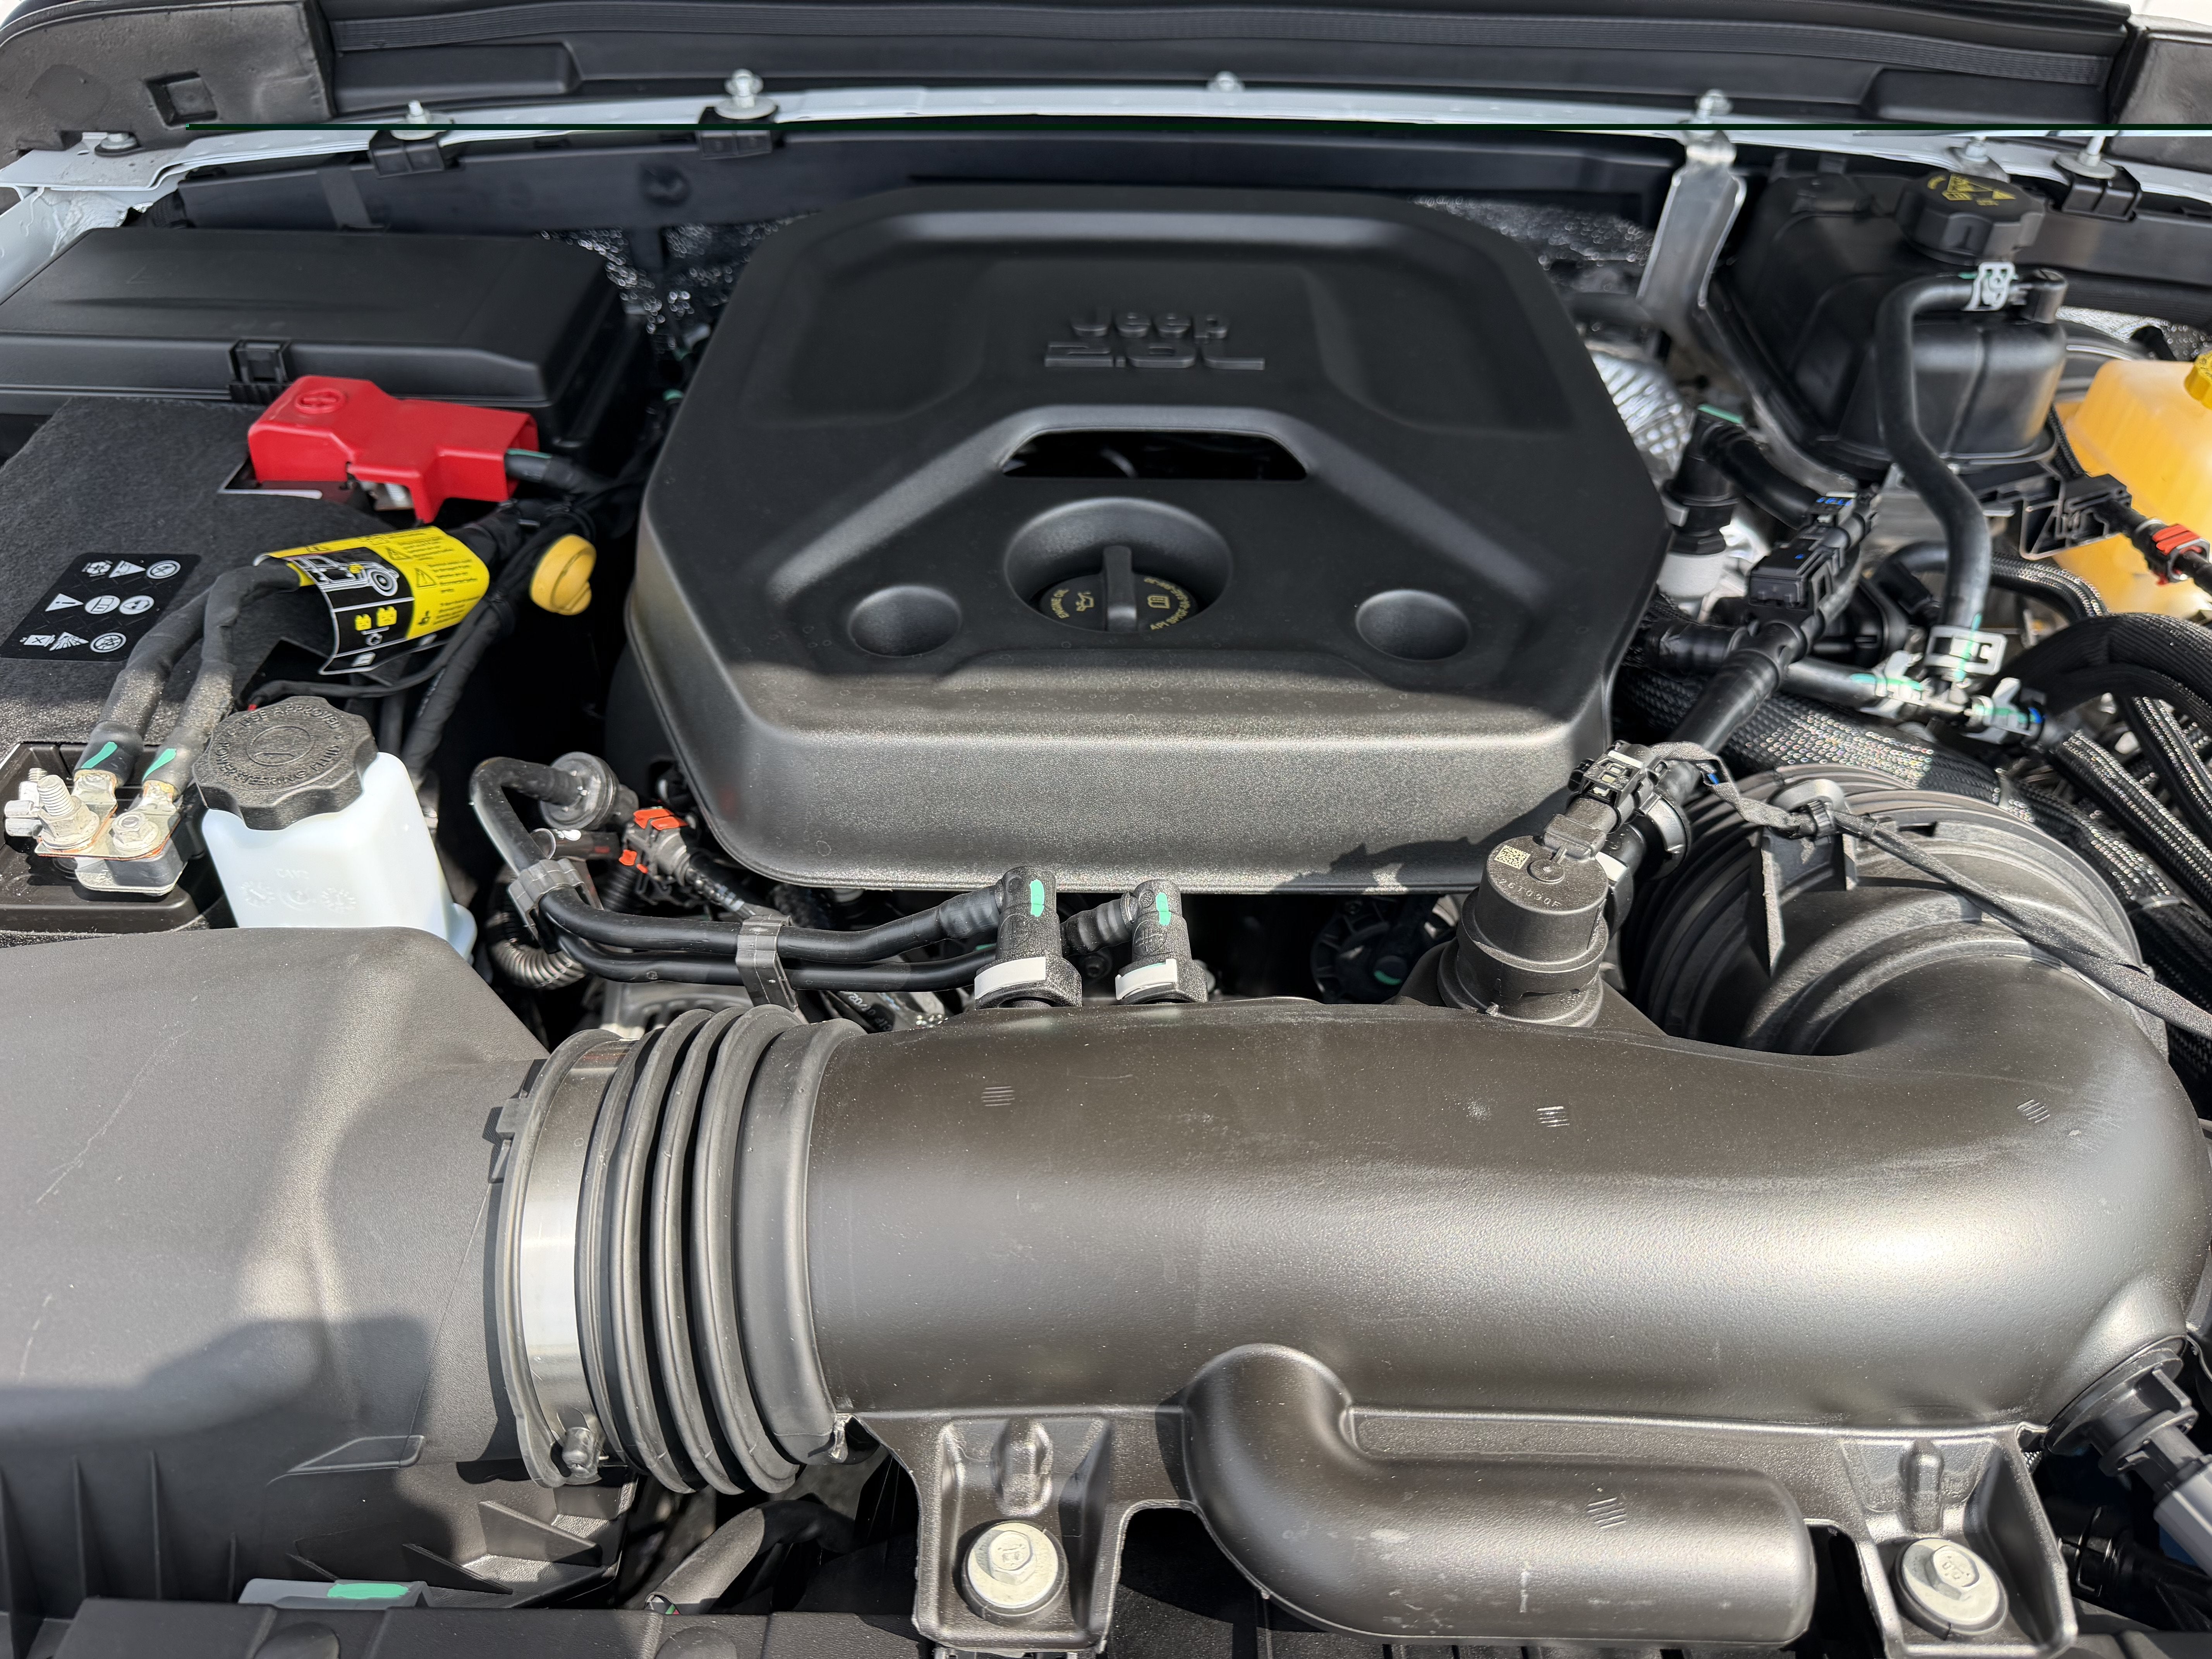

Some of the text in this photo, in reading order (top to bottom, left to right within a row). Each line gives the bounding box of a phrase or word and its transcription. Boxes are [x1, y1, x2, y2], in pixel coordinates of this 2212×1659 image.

[1072, 308, 1229, 343] Jeep
[1051, 589, 1070, 618] ENGINE OIL
[1150, 621, 1169, 630] API
[239, 706, 341, 729] USE APPROVED
[216, 741, 341, 786] POWER STEERING FLUID
